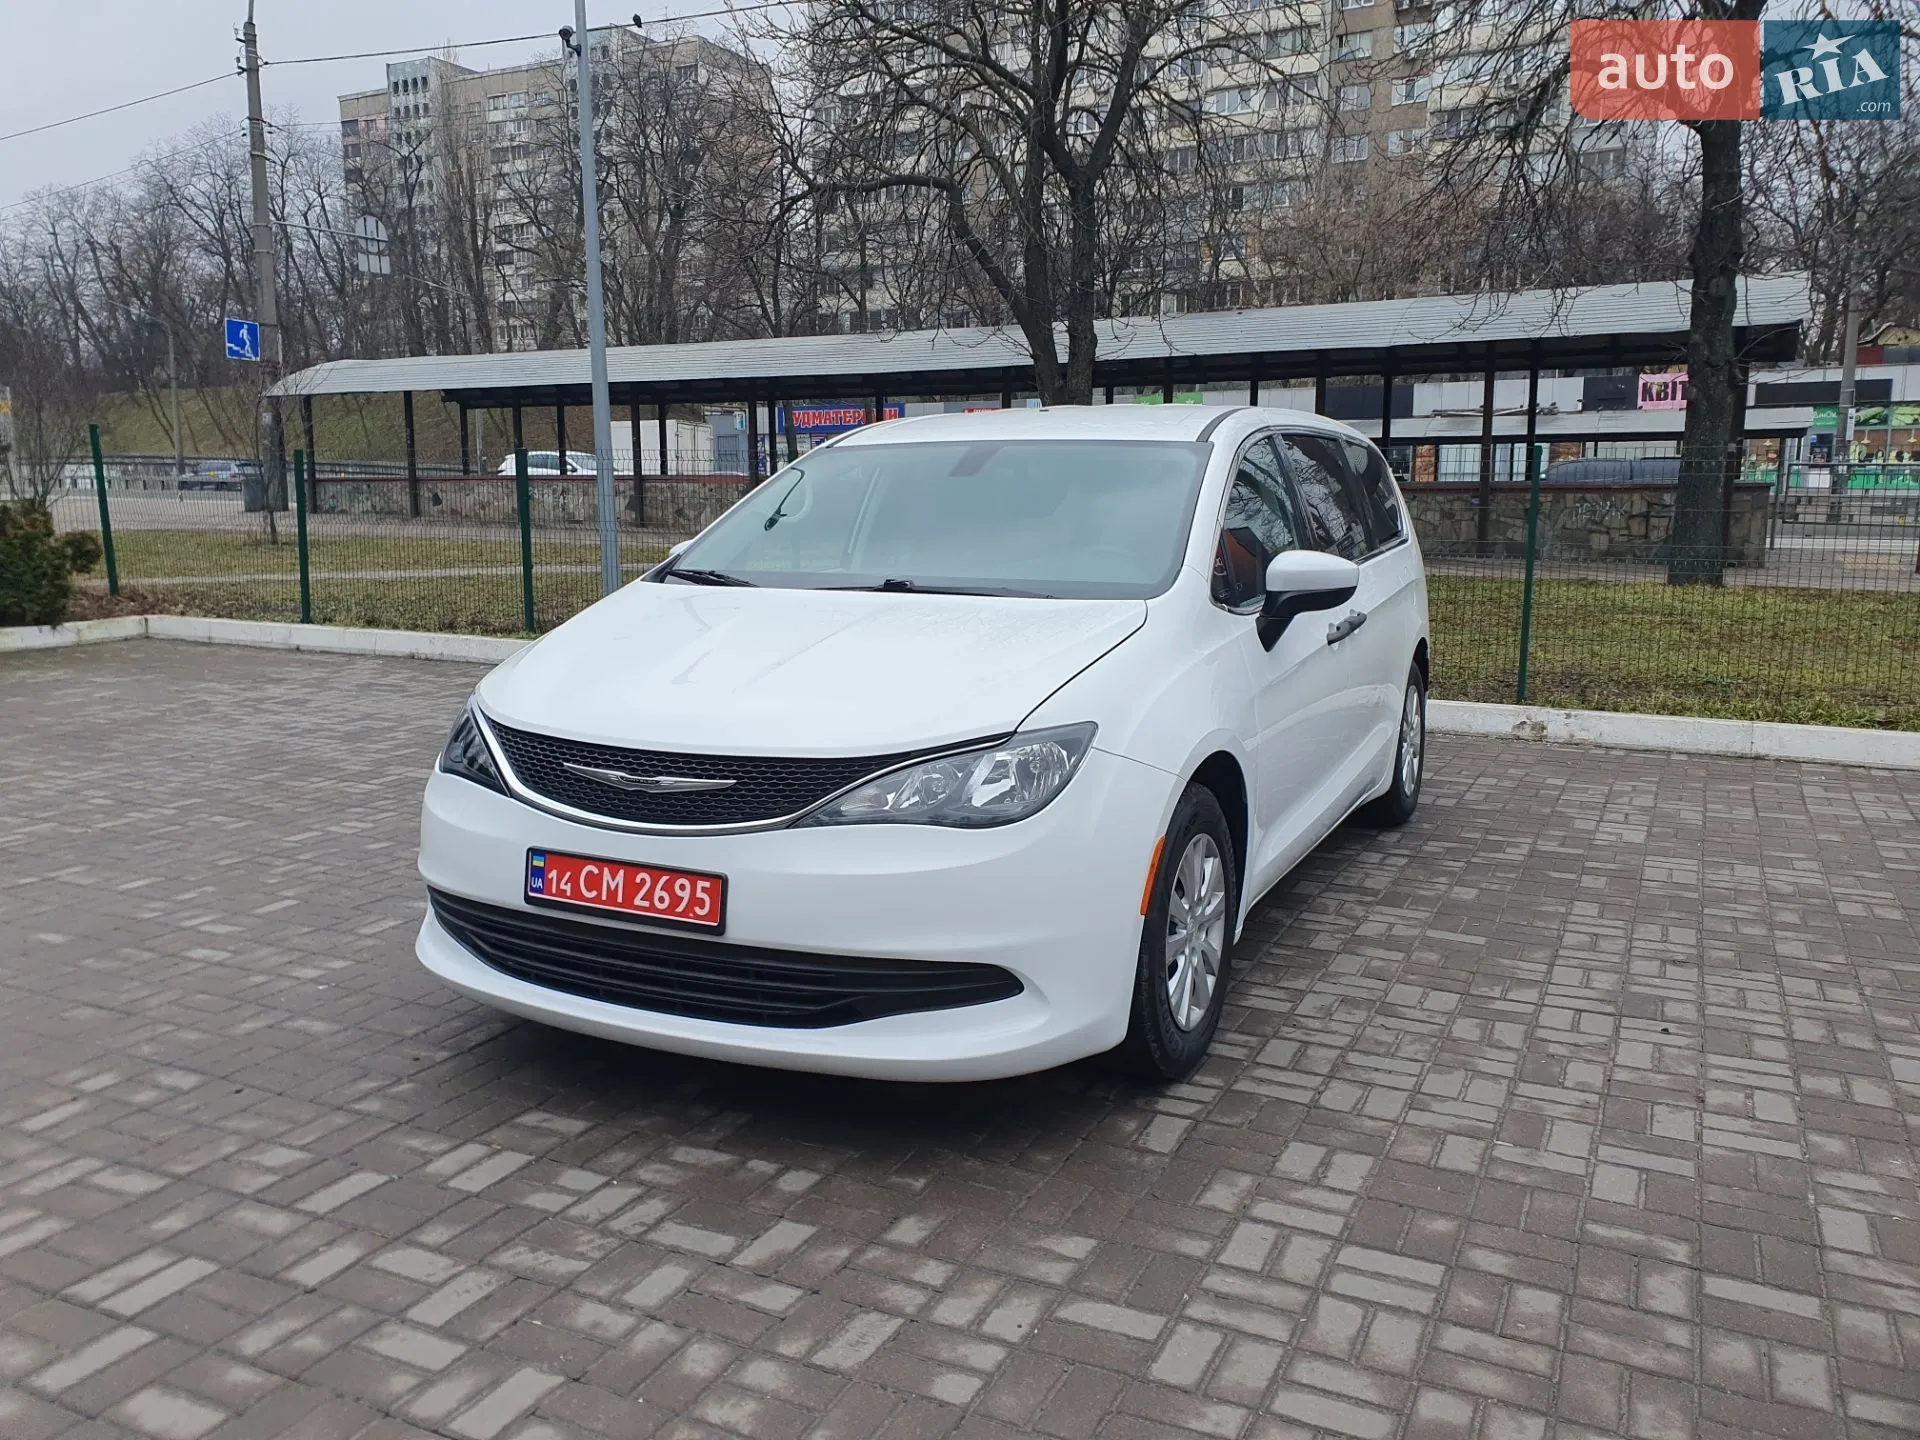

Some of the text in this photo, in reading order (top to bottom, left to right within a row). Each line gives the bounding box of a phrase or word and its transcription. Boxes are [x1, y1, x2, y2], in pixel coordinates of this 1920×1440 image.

[531, 877, 544, 889] UA
[548, 865, 711, 916] 14 CM 2695
